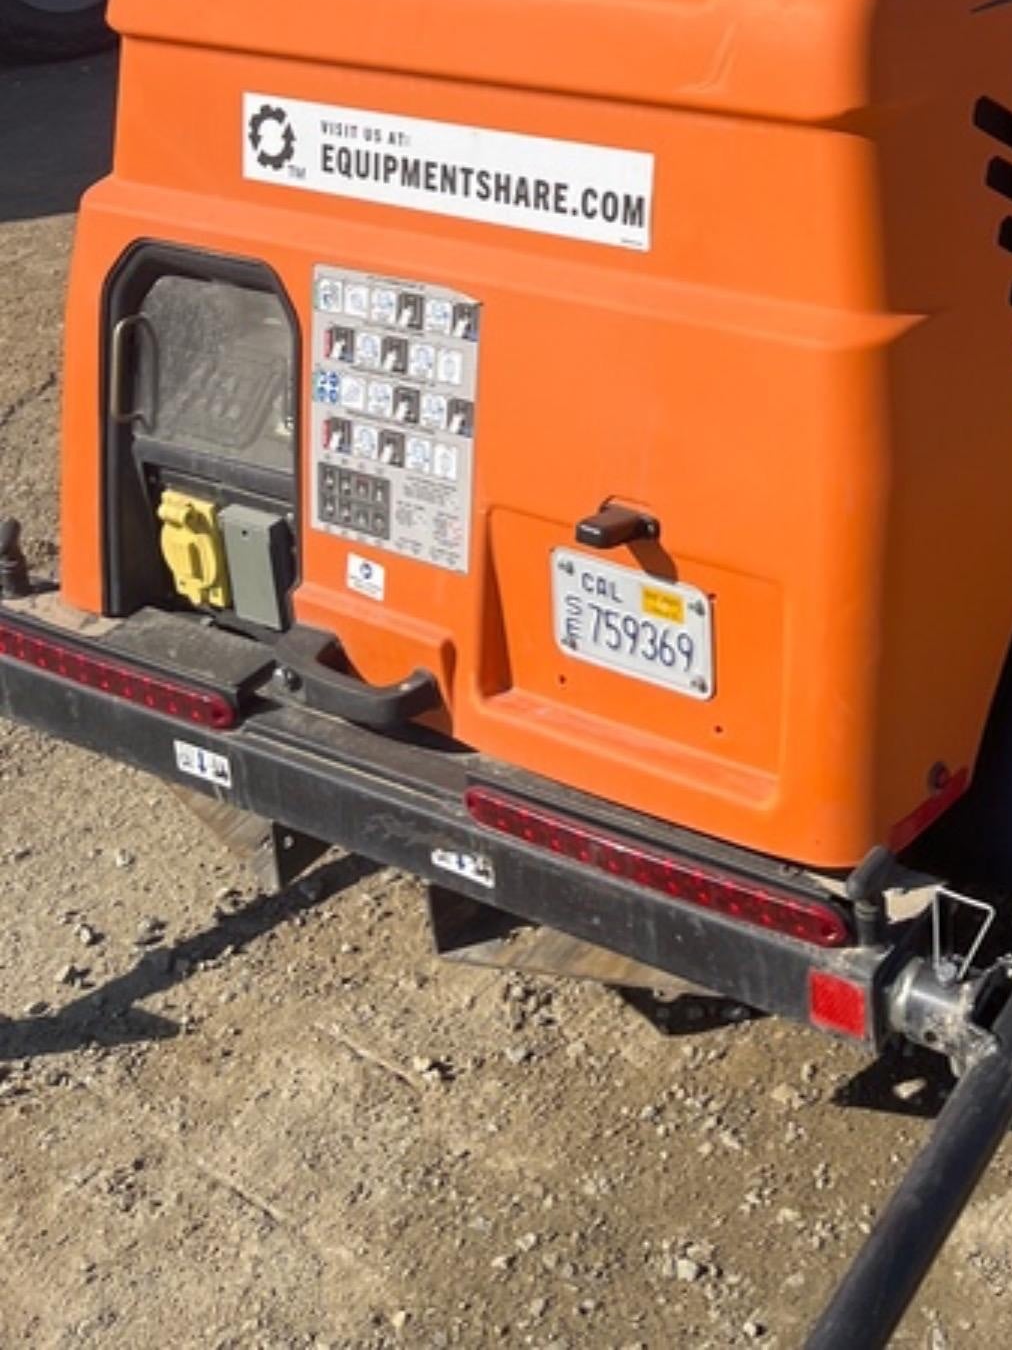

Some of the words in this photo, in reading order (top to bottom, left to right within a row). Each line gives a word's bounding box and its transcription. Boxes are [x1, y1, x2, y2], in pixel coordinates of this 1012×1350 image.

[320, 120, 358, 139] VISIT
[363, 127, 382, 143] US
[320, 143, 646, 229] EQUIPMENTSHARE.COM
[581, 572, 623, 603] CAL
[587, 602, 695, 672] 759369
